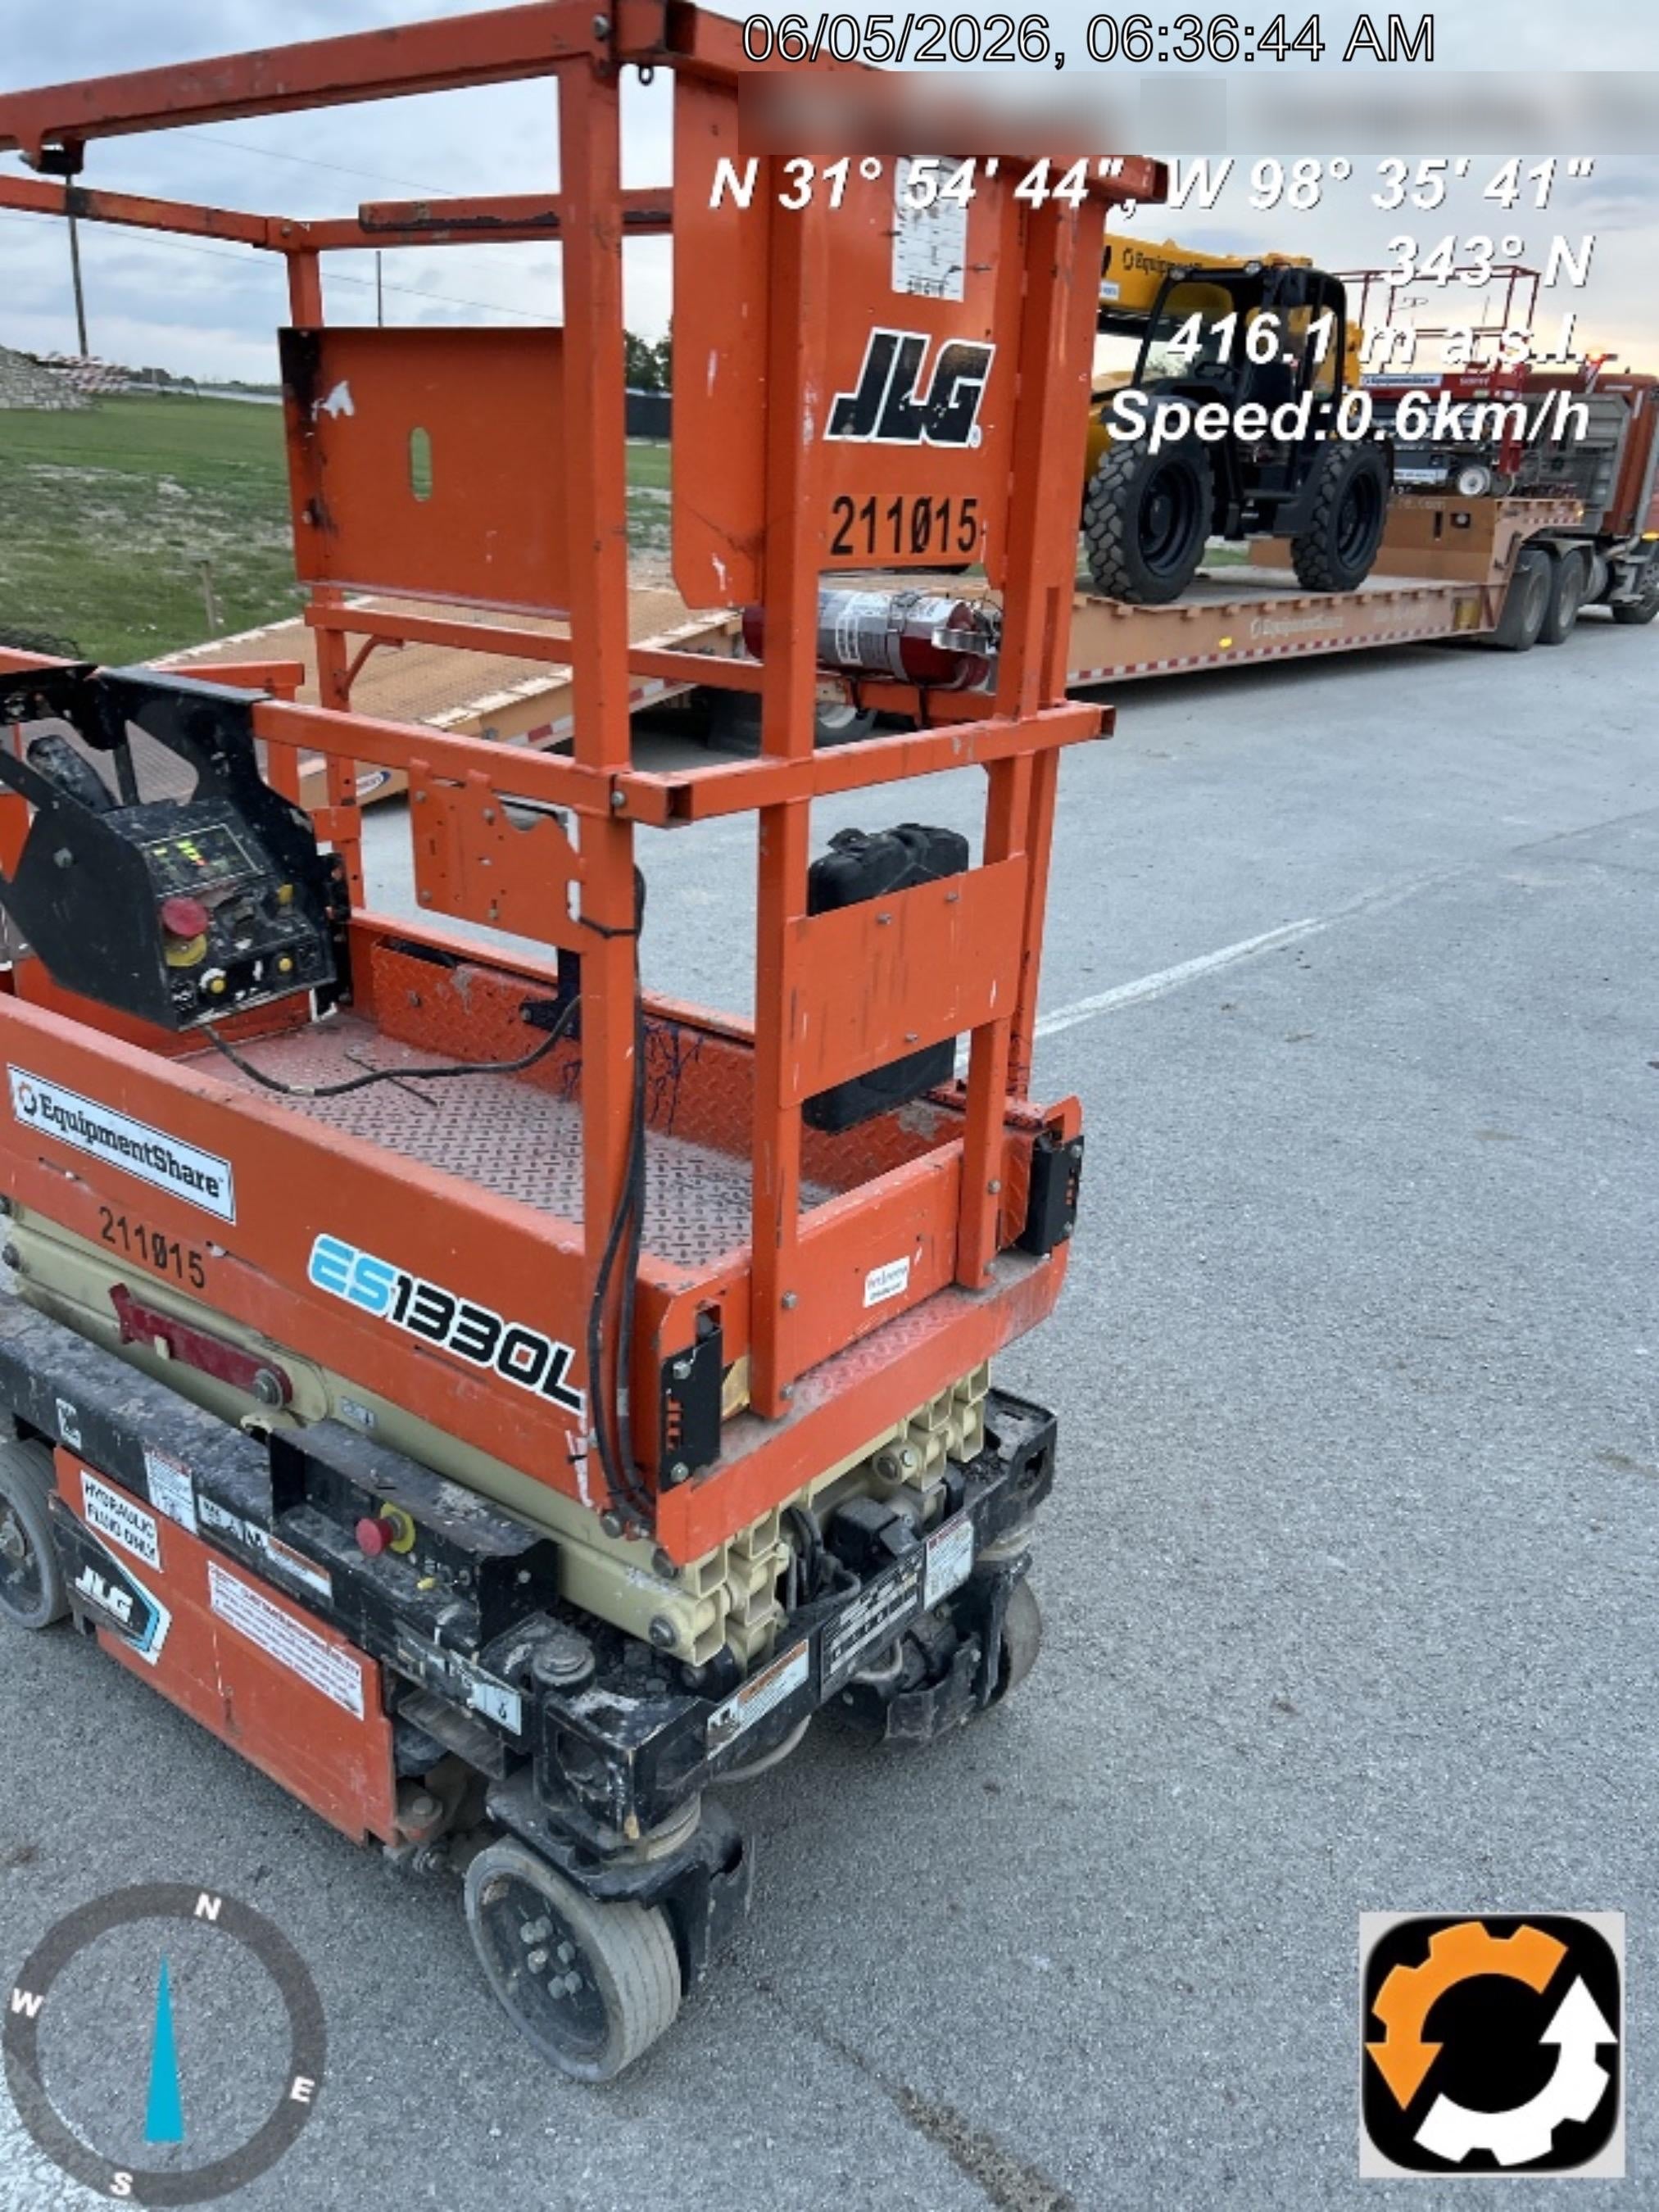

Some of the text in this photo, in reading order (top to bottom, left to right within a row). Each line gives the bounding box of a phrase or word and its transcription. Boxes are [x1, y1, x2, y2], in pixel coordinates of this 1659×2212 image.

[823, 327, 995, 447] JLG
[830, 495, 977, 555] 211015
[38, 1093, 220, 1198] EquipmentShare
[99, 1206, 205, 1288] 211015
[307, 1233, 586, 1416] ES1330L
[75, 1565, 134, 1624] JLG
